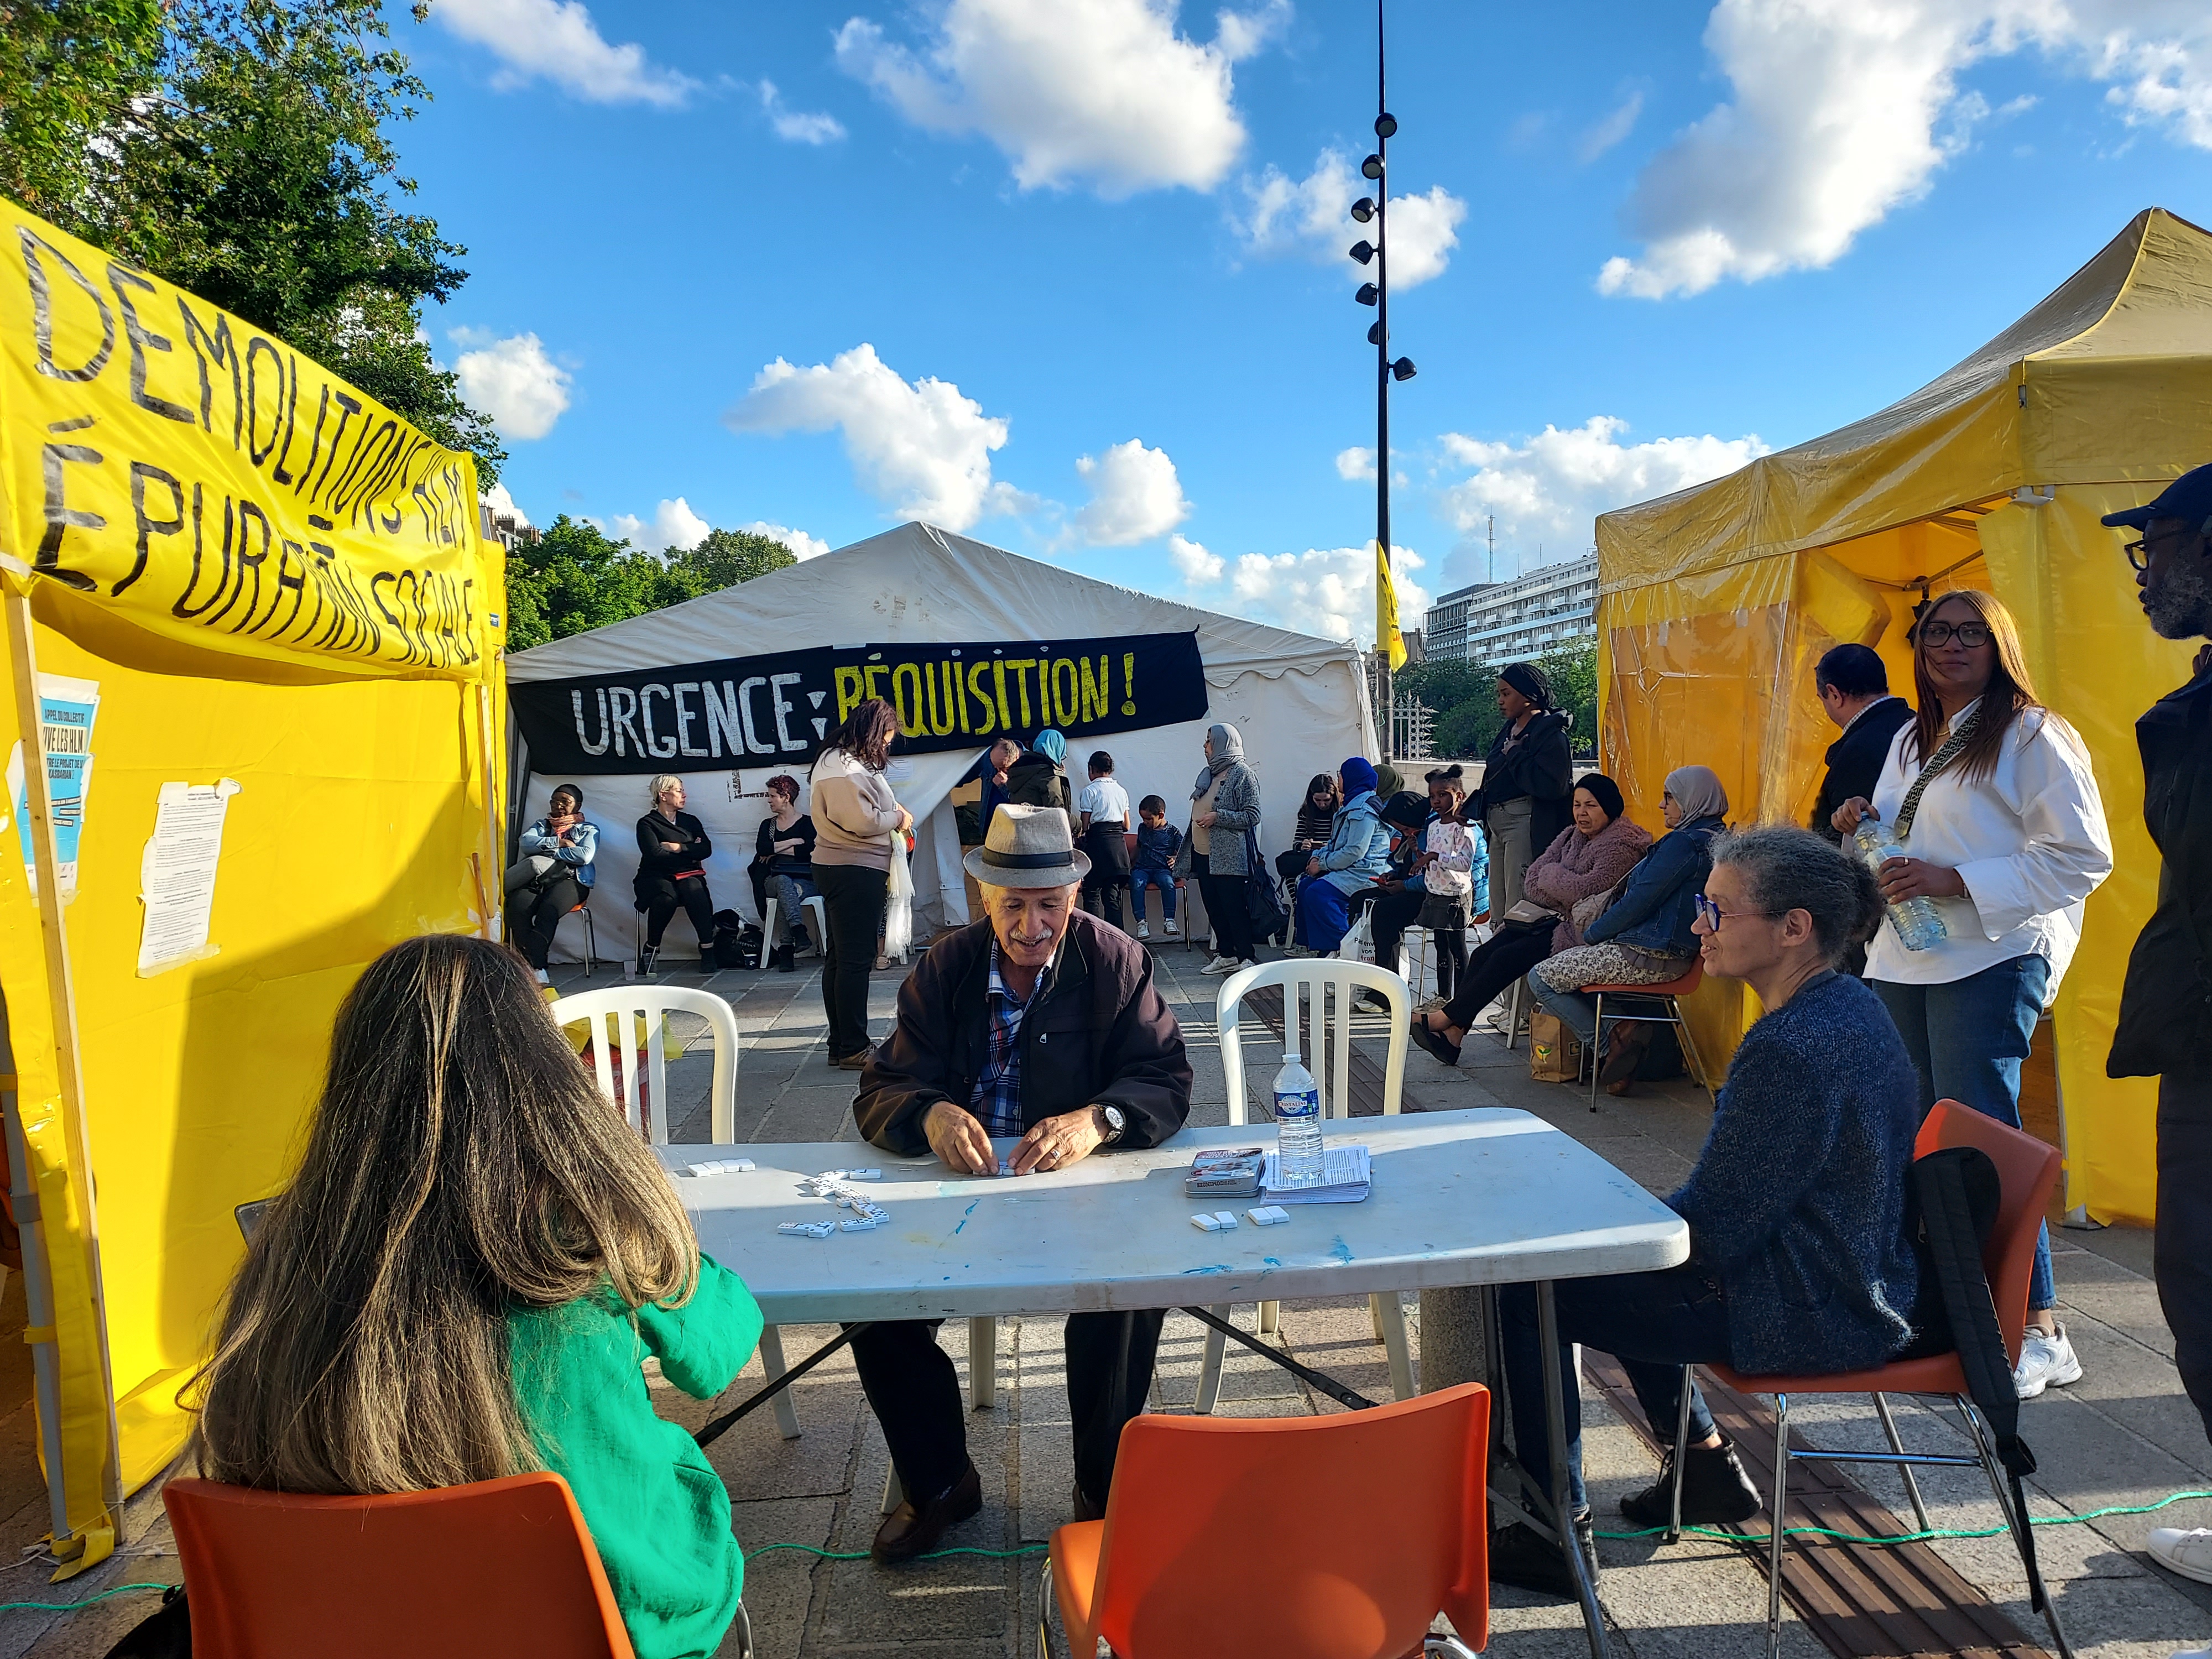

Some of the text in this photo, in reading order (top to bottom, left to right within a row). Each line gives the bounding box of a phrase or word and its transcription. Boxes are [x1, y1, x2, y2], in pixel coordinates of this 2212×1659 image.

[371, 569, 479, 669] SOCIALE
[57, 727, 68, 753] LES
[69, 729, 84, 753] HLM
